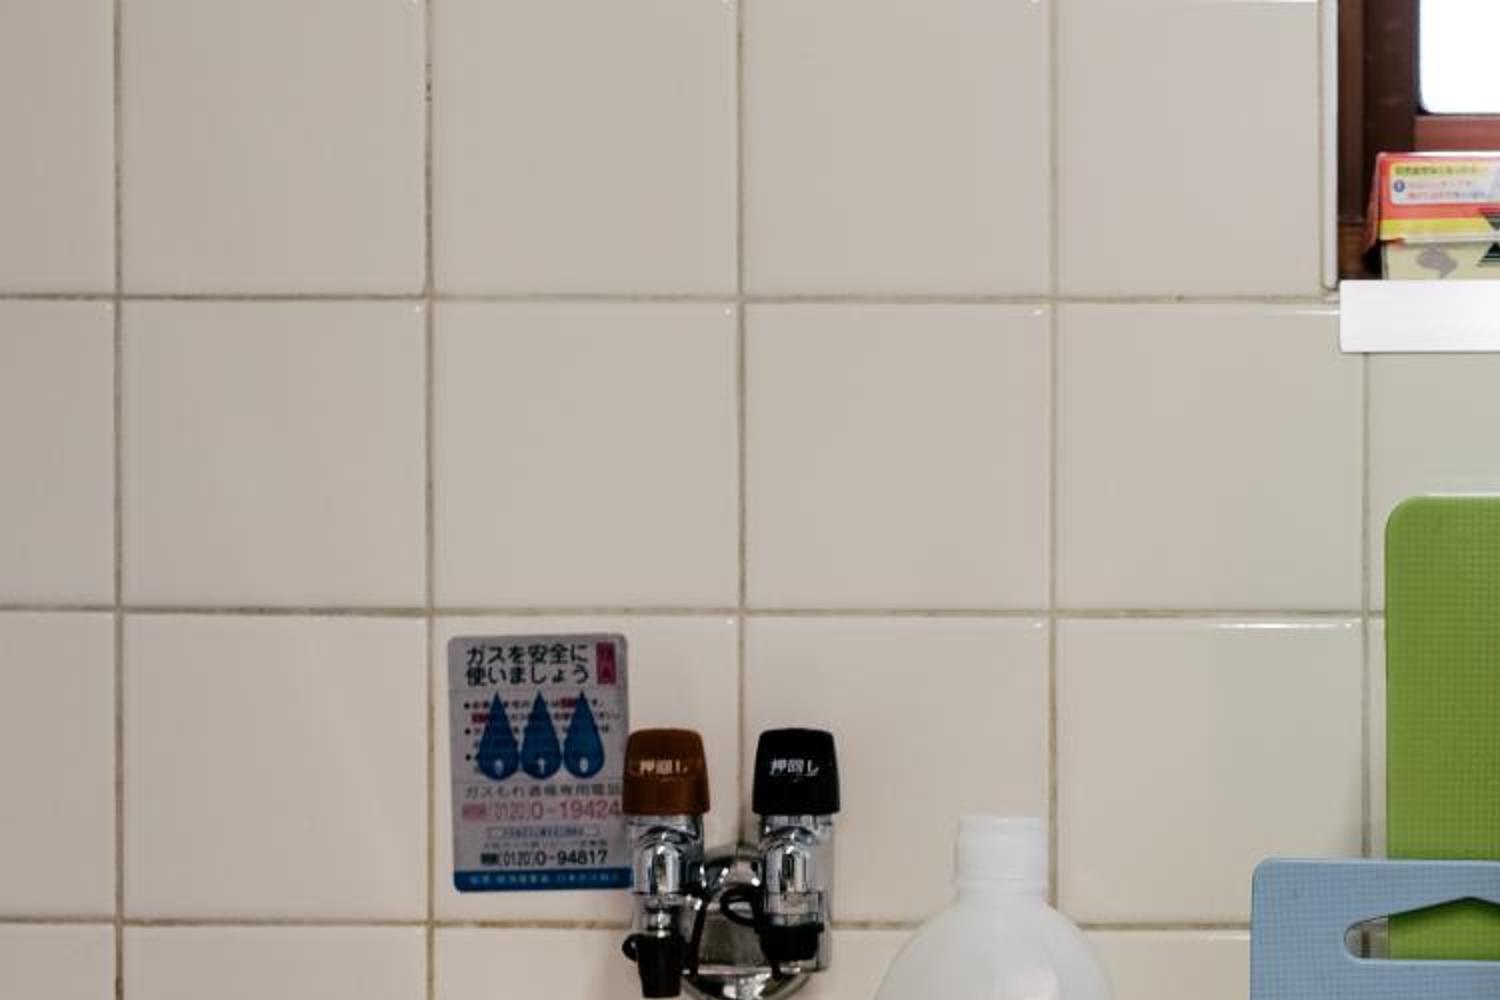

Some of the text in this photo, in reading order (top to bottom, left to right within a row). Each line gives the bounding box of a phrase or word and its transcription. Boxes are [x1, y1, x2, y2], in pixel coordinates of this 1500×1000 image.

[466, 642, 588, 665] ガスを安全に
[466, 666, 589, 686] 使いましょう
